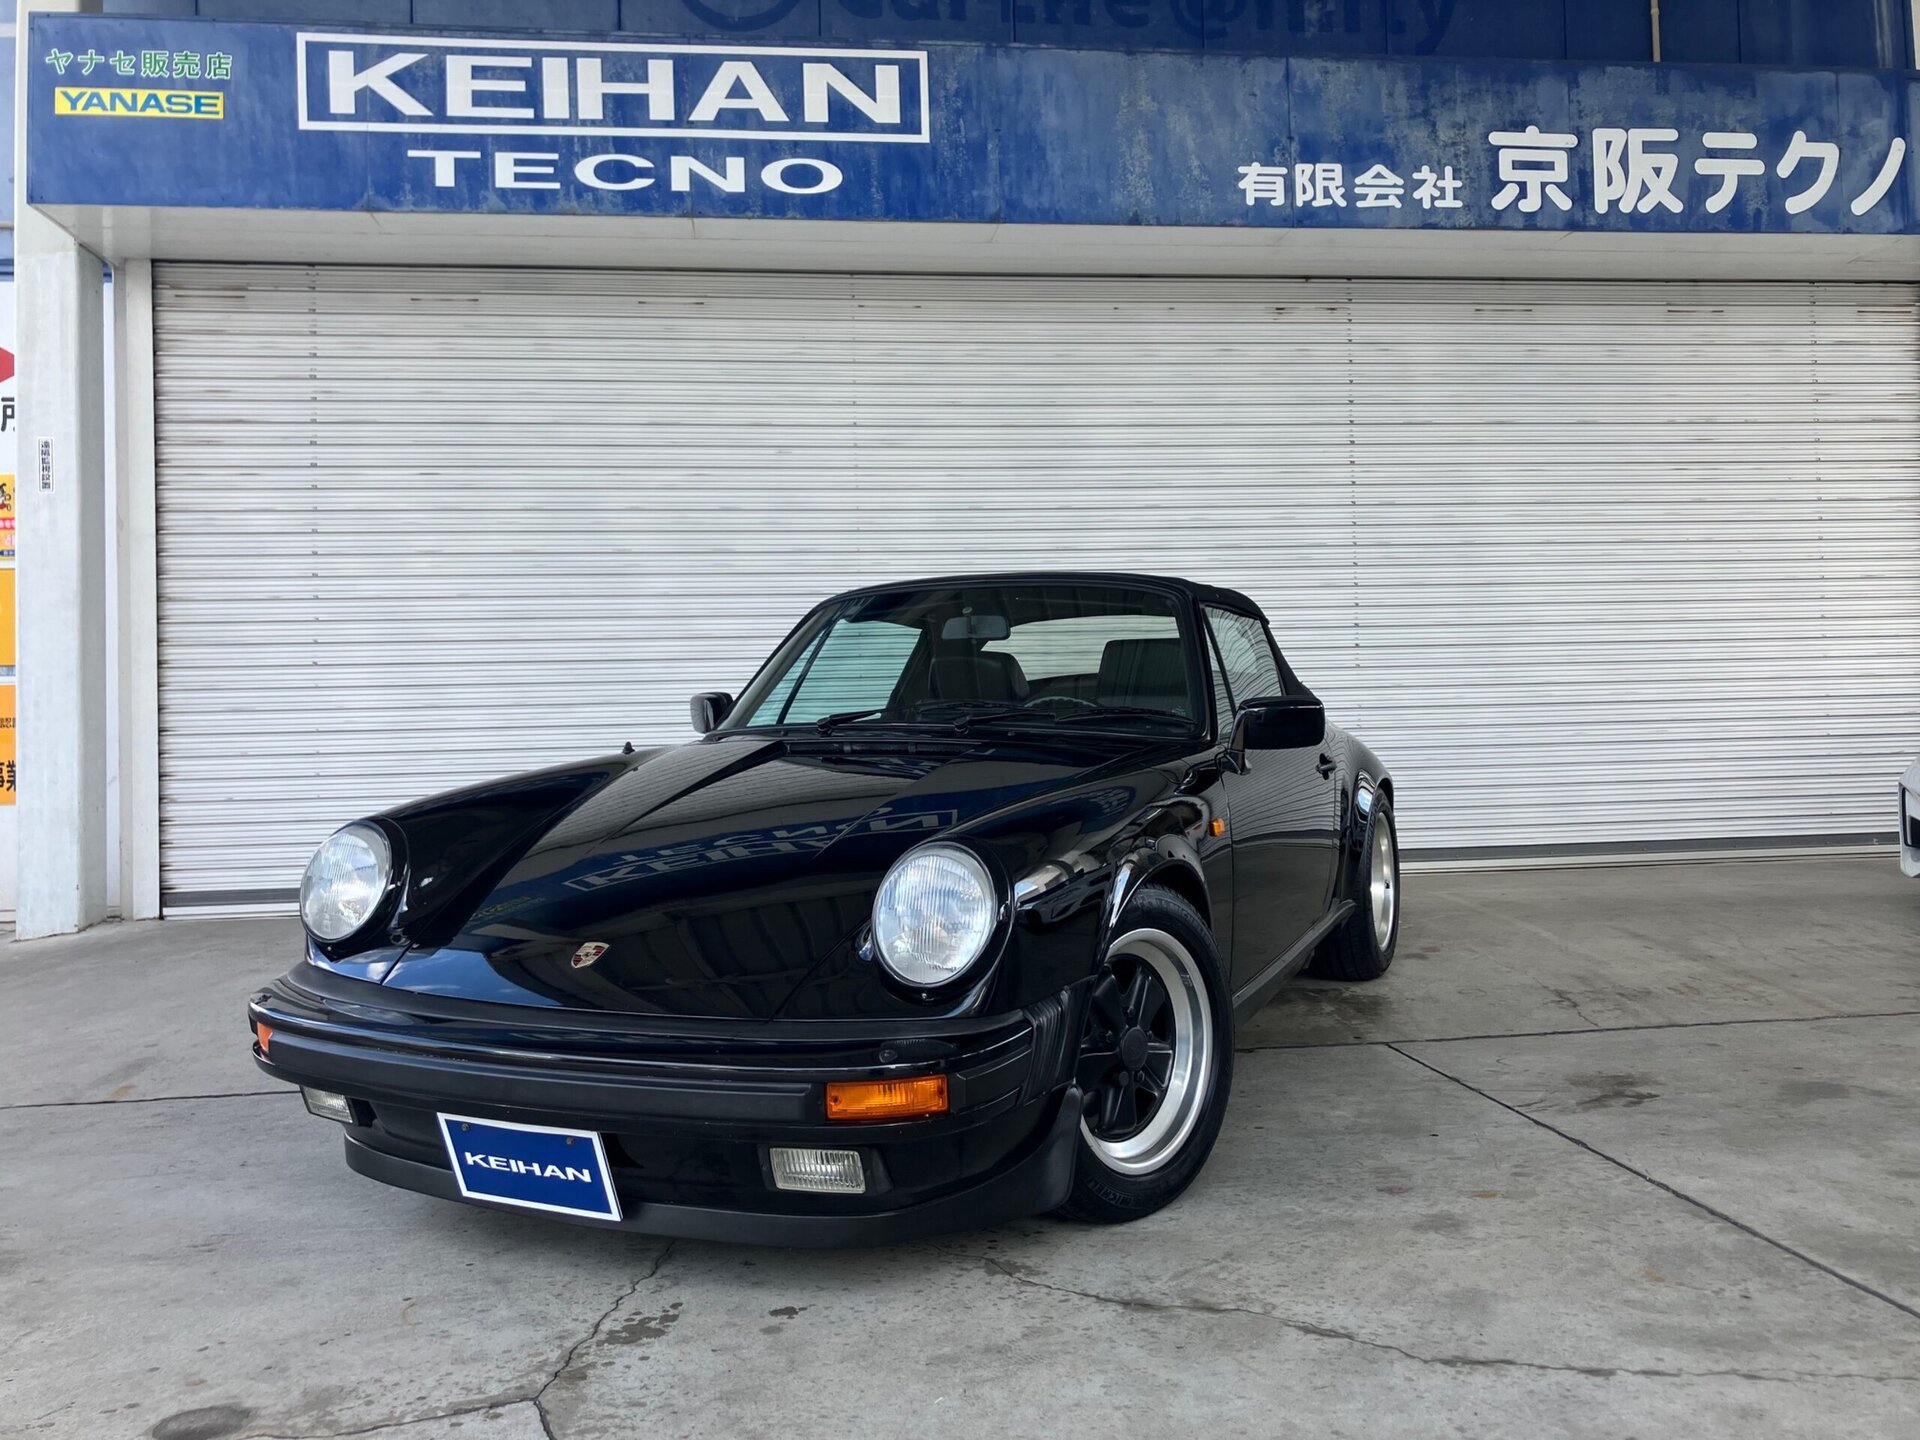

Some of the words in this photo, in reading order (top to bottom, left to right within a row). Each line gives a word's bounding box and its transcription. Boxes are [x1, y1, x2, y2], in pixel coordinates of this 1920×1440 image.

[45, 48, 233, 80] ヤナセ販売店
[60, 90, 220, 114] YANASE
[328, 49, 901, 124] KEIHAN
[407, 149, 843, 195] TECNO
[1237, 162, 1464, 210] 有限会社
[1488, 125, 1906, 216] 京阪テクノ
[464, 1151, 592, 1183] KEIHAN
